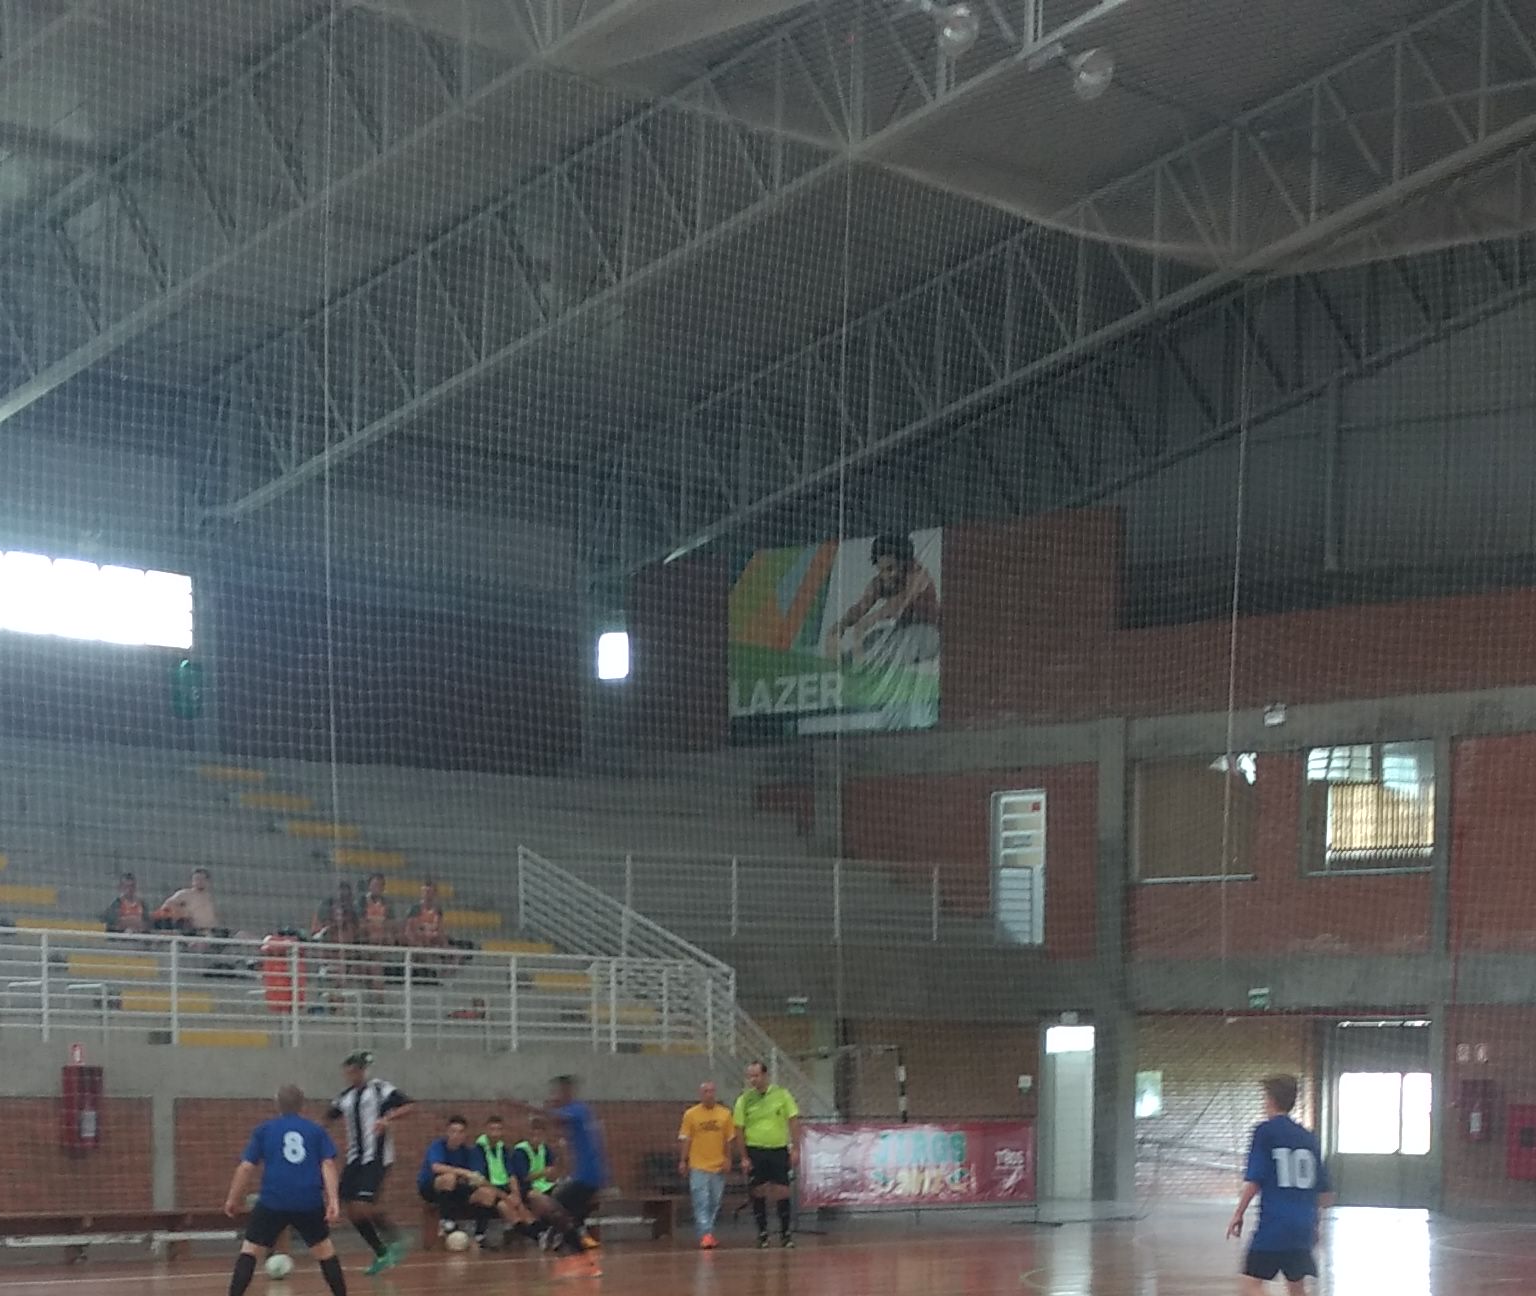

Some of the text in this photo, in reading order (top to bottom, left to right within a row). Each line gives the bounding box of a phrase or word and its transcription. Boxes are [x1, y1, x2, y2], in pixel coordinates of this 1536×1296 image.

[729, 671, 843, 715] LAZER
[283, 1131, 307, 1165] 8
[1272, 1147, 1317, 1189] 10
